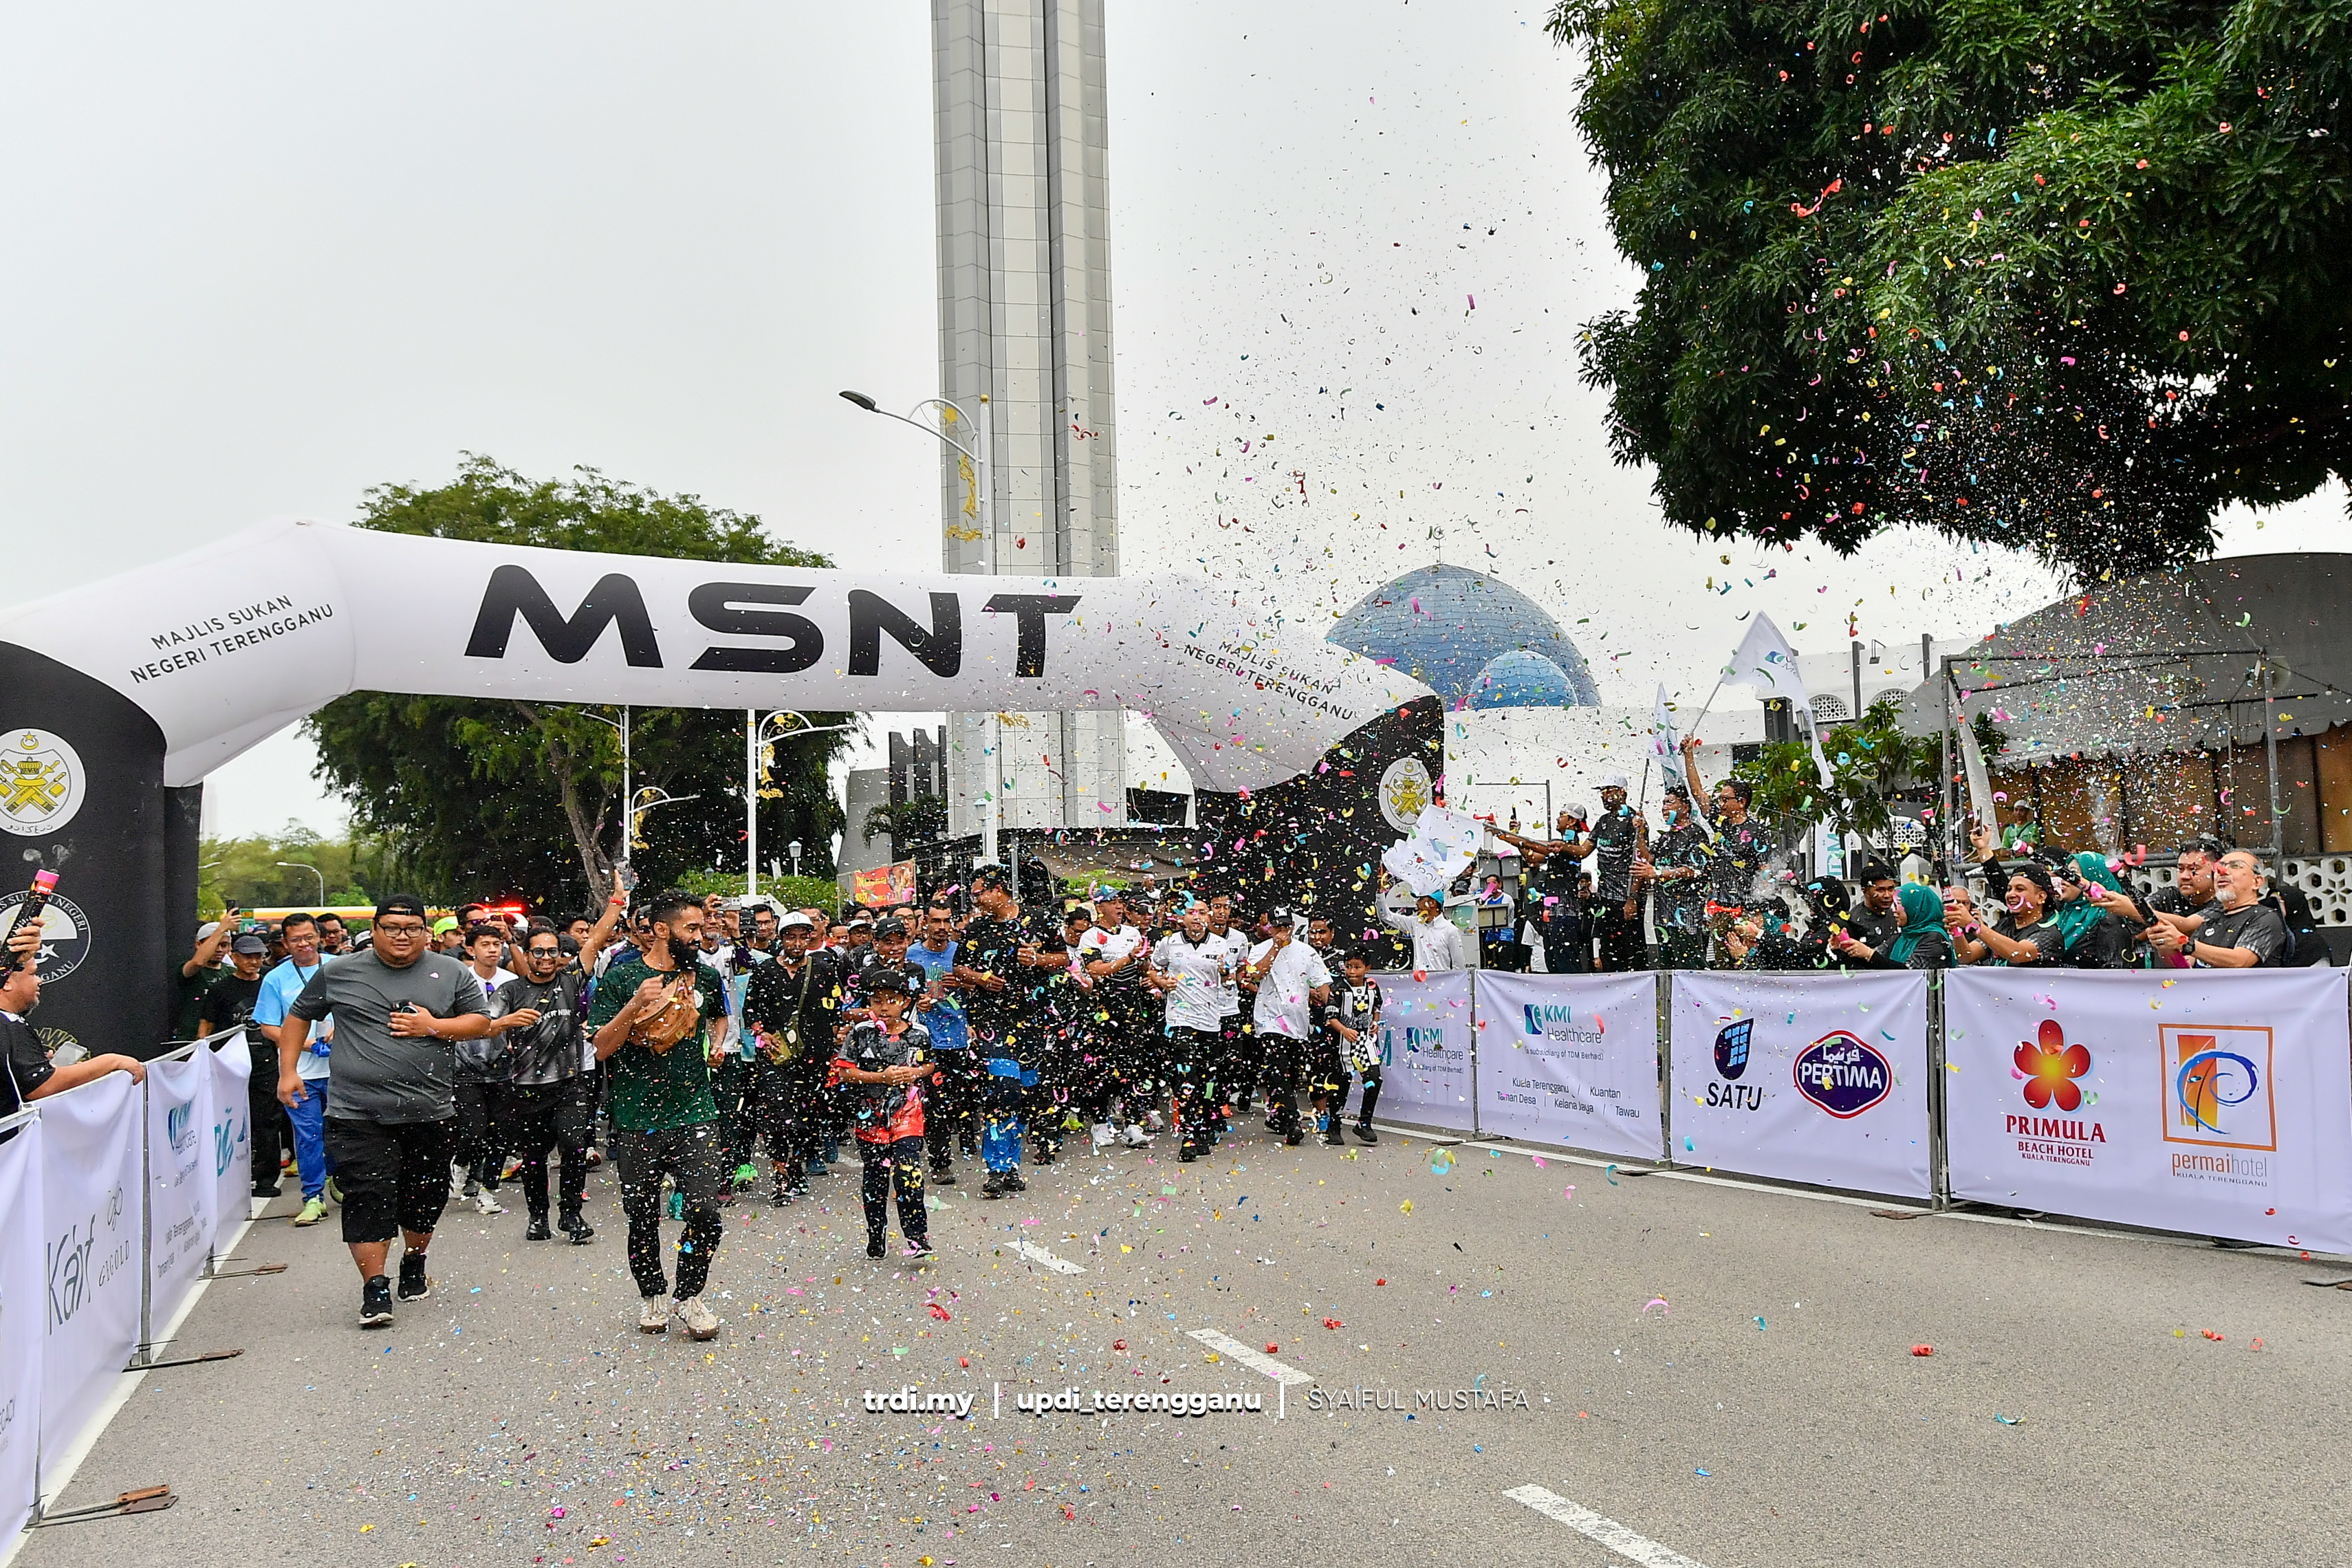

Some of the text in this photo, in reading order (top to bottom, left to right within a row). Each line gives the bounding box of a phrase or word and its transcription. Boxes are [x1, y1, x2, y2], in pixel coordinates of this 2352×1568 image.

[151, 595, 293, 651] MAJLIS SUKAN
[464, 564, 1083, 679] MSNT
[130, 604, 334, 684] NEGERI TERENGGANU
[1219, 641, 1333, 695] MAJLIS SUKAN
[1184, 644, 1353, 721] NEGERI TERENGGANU
[8, 893, 54, 904] SUN
[55, 898, 87, 931] NEGERI
[1544, 1005, 1571, 1023] KMI
[1422, 1027, 1443, 1043] KMI
[1547, 1027, 1602, 1044] Healthcare
[1423, 1047, 1463, 1060] Healthcare
[1530, 1049, 1560, 1058] subsidiary
[1568, 1051, 1580, 1059] TDM
[1581, 1052, 1604, 1061] Berhad)
[1512, 1077, 1621, 1099] Kuala Terengganu Kuantan
[1801, 1063, 1882, 1089] PERTIMA
[1496, 1091, 1518, 1102] Taman
[1518, 1093, 1536, 1105] Desa
[1554, 1098, 1578, 1110] Kelana
[1615, 1106, 1640, 1118] Tawau
[1706, 1082, 1763, 1111] SATU
[2006, 1114, 2107, 1143] PRIMULA
[2018, 1141, 2094, 1159] BEACH HOTEL
[2022, 1152, 2091, 1166] KUALA TERENGGANU
[2176, 1172, 2267, 1187] KUALA TERENGGANU
